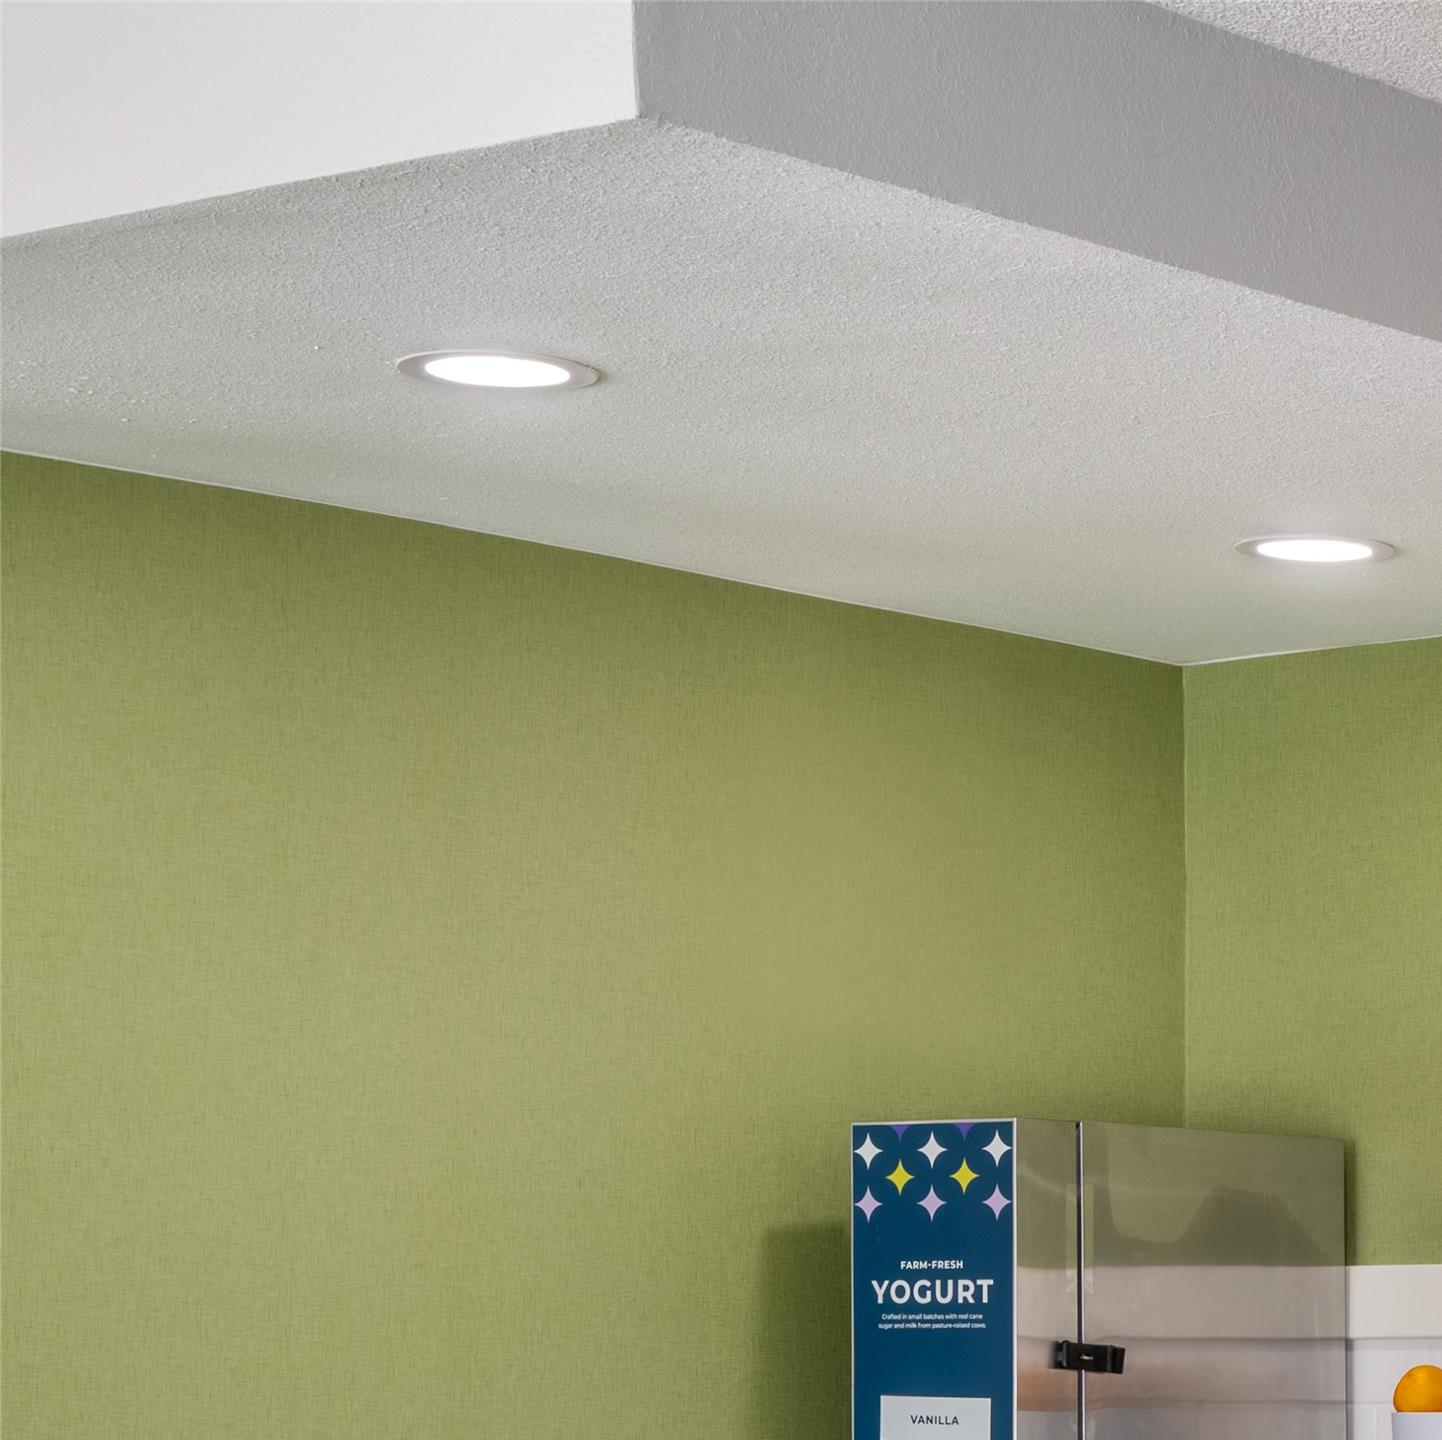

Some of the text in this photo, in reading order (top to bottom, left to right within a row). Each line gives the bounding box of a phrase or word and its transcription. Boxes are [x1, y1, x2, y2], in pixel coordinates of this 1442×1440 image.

[900, 1260, 964, 1270] FARM-FRESH
[871, 1279, 994, 1304] YOGURT
[910, 1414, 960, 1425] VANILLA
